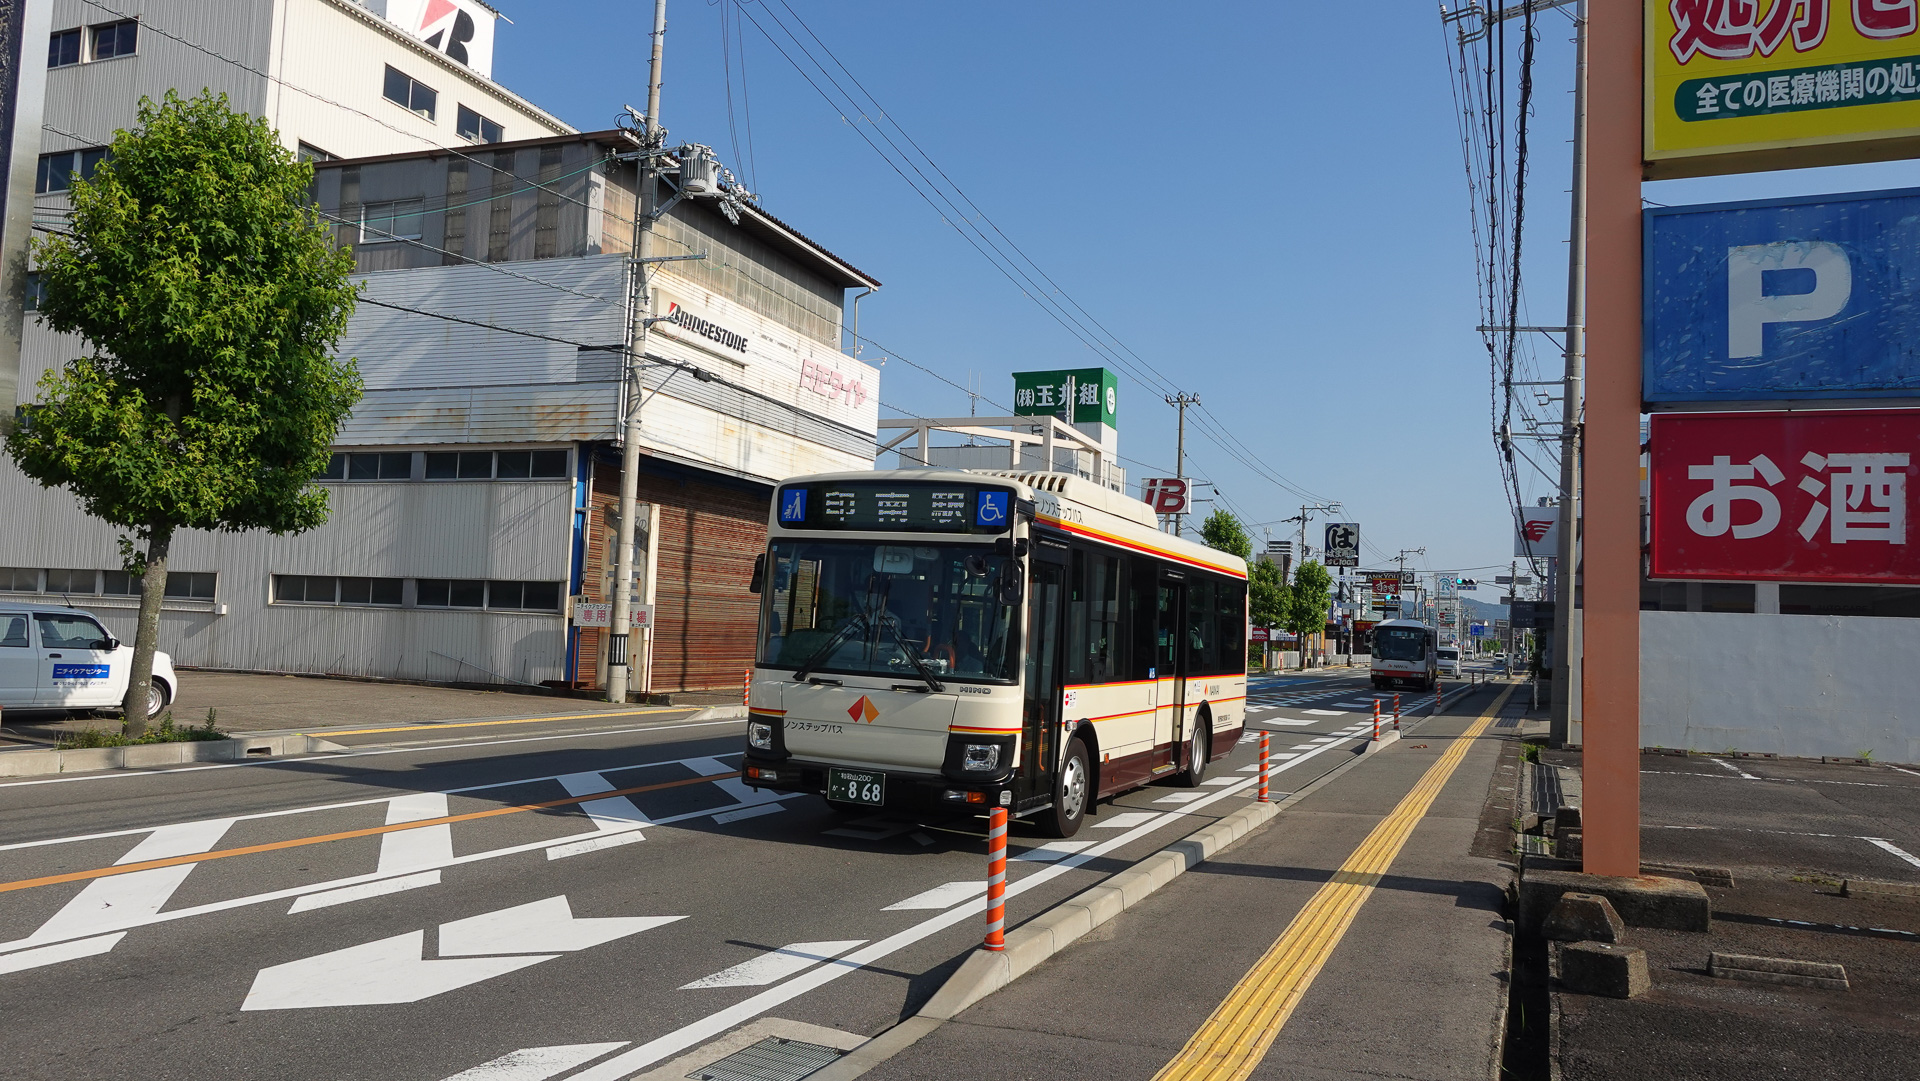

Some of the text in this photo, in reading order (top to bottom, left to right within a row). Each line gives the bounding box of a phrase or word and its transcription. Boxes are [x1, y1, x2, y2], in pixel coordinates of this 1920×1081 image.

[1696, 62, 1920, 114] 全ての医療機関の処
[1728, 241, 1852, 358] P
[669, 302, 749, 353] BRIDGESTONE
[800, 358, 868, 409] 日正タイヤ
[1686, 451, 1910, 545] お酒
[1040, 499, 1084, 524] ノンステップバス
[1331, 527, 1355, 549] は
[1375, 580, 1396, 593] すき家
[583, 610, 647, 624] 専用場
[960, 686, 992, 695] HINO
[784, 721, 844, 735] ノンステップバス
[841, 772, 872, 783] 和歌山200
